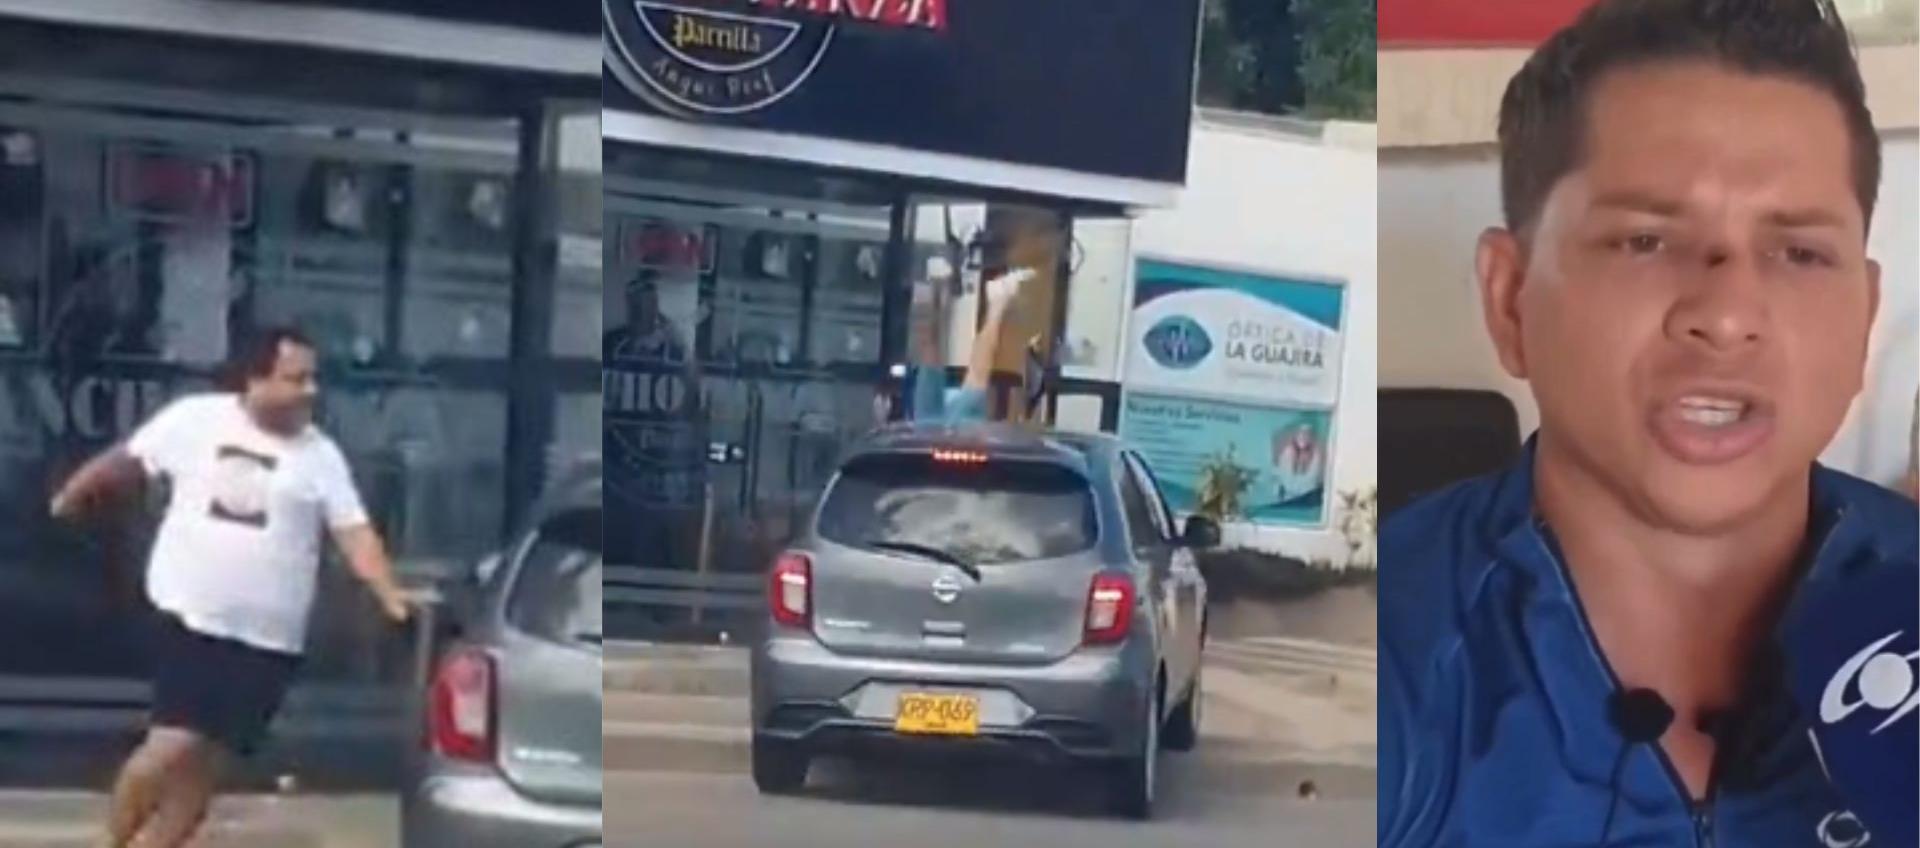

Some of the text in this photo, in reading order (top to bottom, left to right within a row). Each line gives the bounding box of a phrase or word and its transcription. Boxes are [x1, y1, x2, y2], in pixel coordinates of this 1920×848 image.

[672, 12, 761, 53] Parrilla
[1224, 338, 1324, 368] LA GUAJIRA
